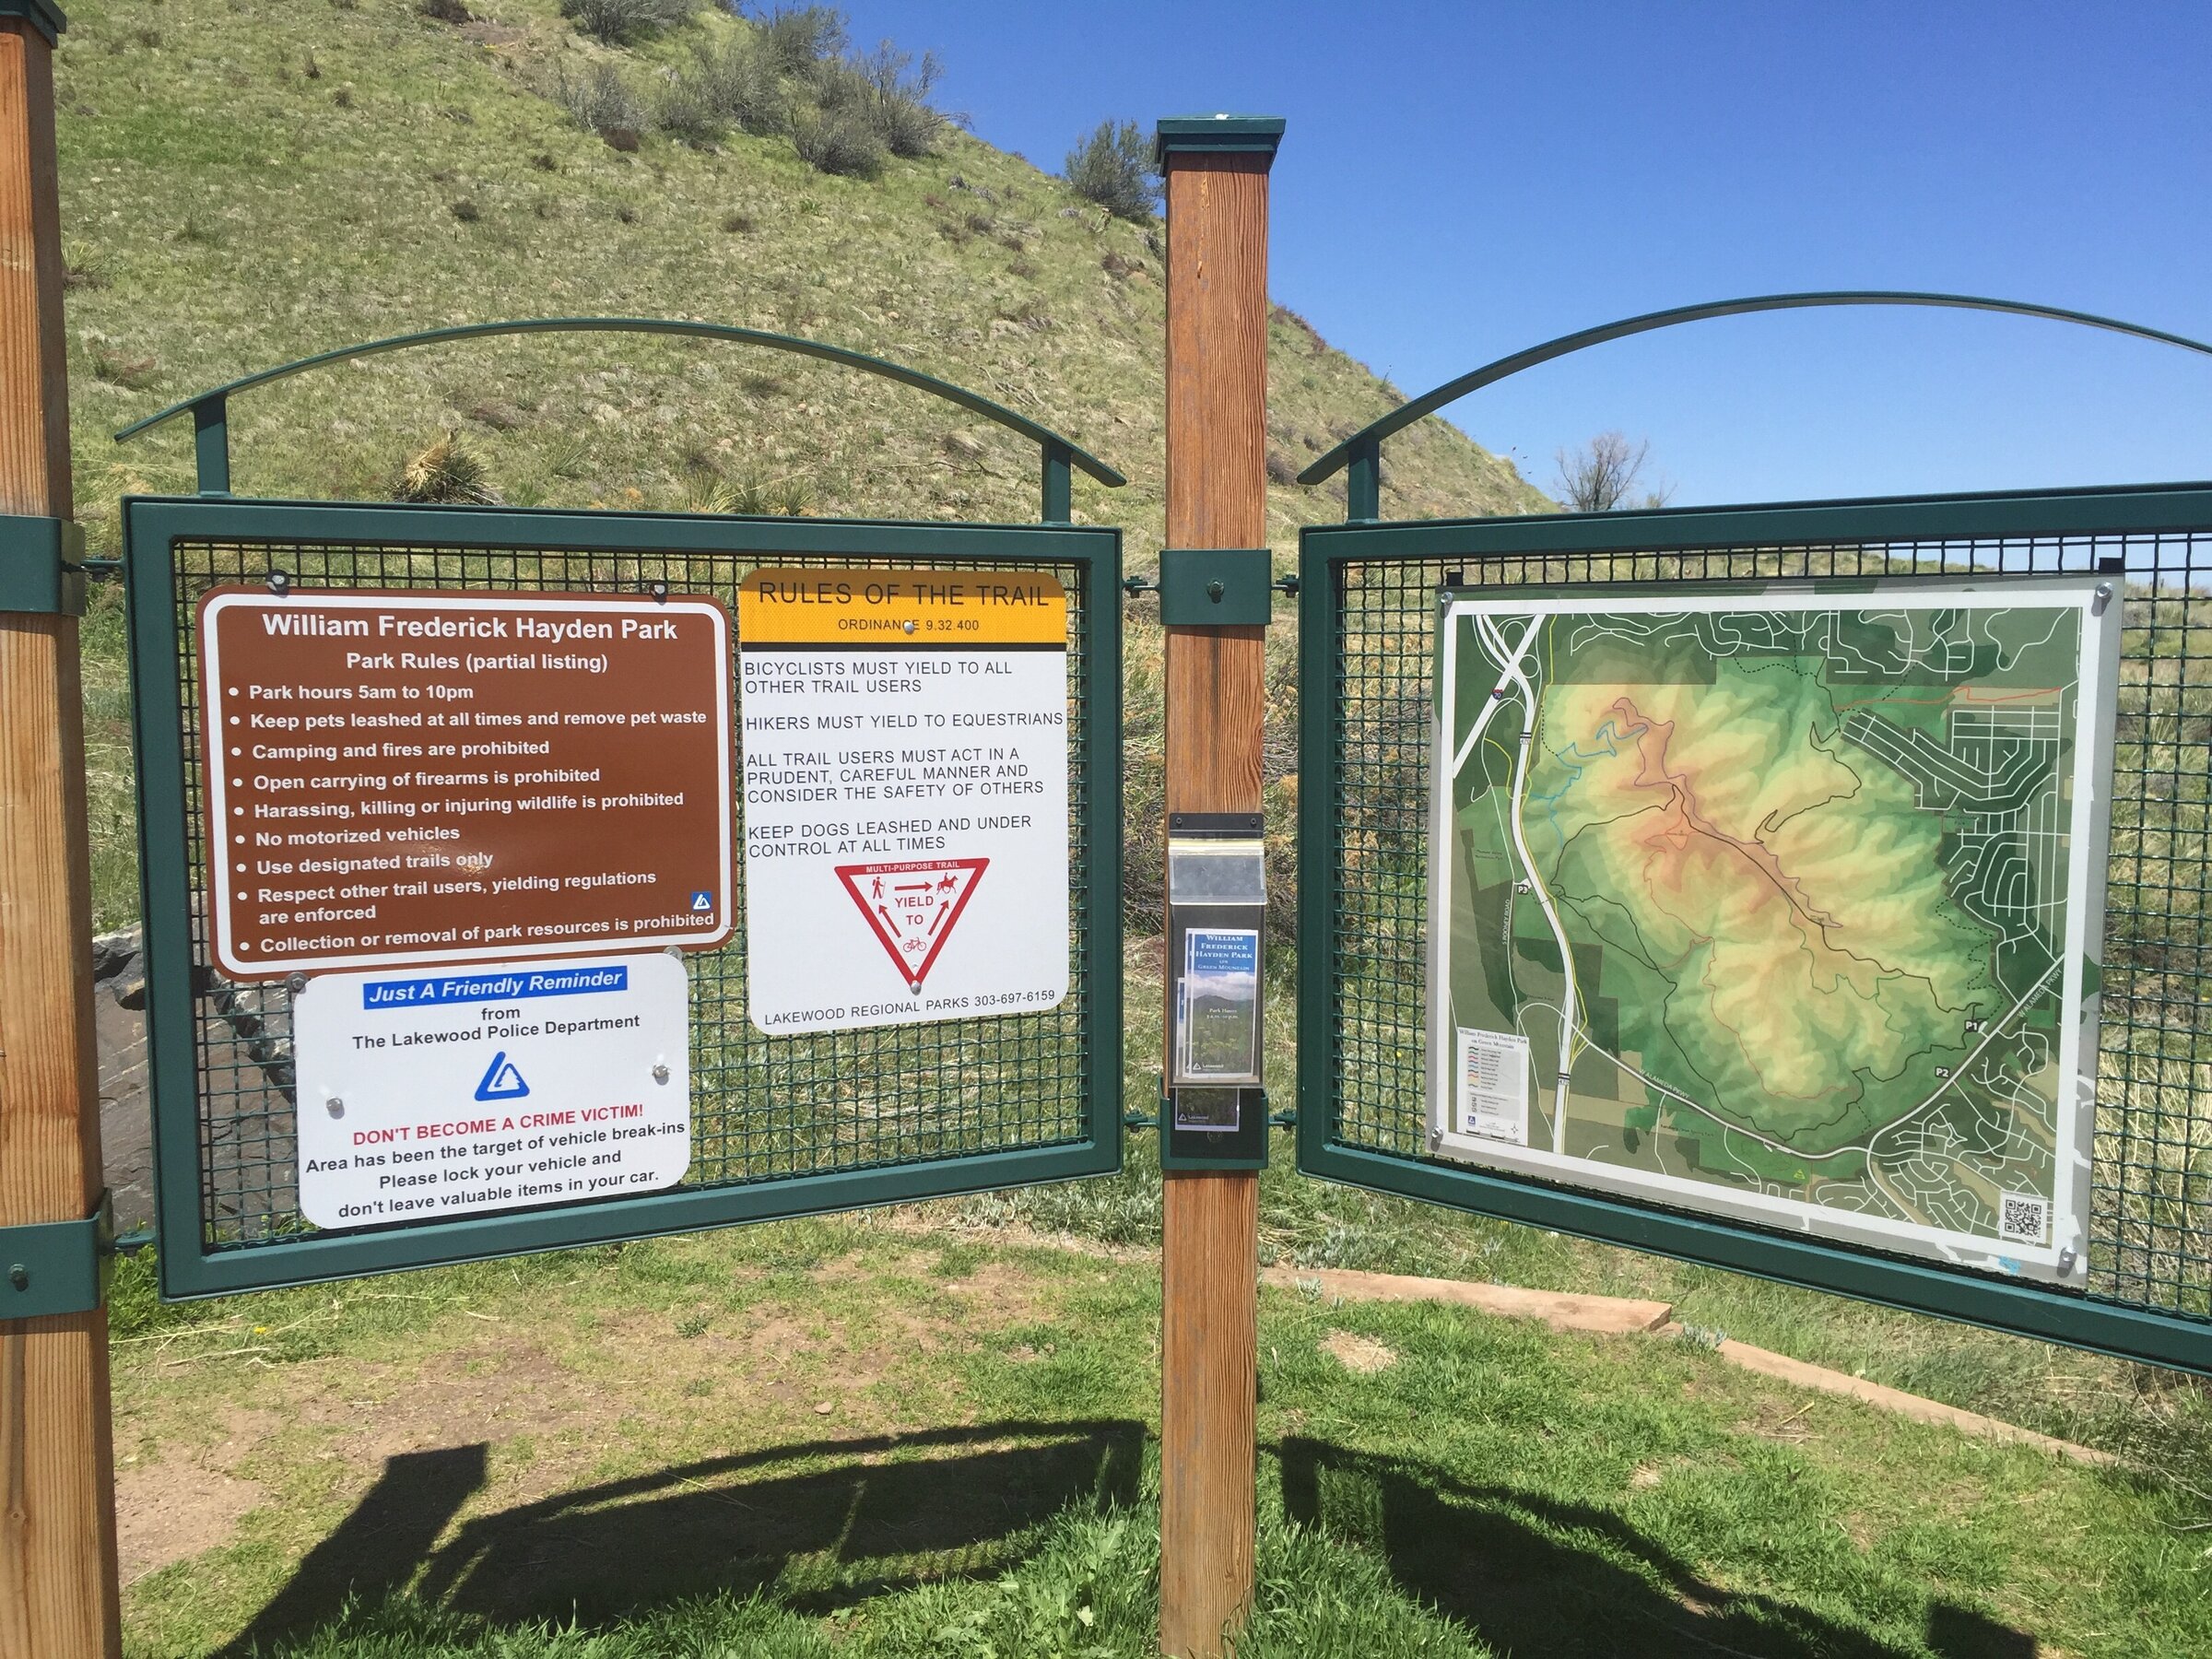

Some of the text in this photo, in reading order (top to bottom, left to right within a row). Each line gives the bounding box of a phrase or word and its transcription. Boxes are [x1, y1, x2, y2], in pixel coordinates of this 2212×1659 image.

[759, 582, 1049, 606] RULES OF THE TRAIL
[263, 614, 677, 643] William Frederick Hayden Park
[926, 619, 979, 630] 9.32.400
[347, 653, 607, 673] Park Rules (partial listing)
[746, 662, 1012, 676] BICYCLISTS MUST YIELD TO ALL
[250, 685, 473, 701] Park hours 5am to 10pm
[746, 679, 921, 693] OTHER TRAIL USERS
[251, 712, 706, 731] Keep pets leashed at all times and remove pet waste
[747, 712, 1063, 730] HIKERS MUST YIELD TO EQUESTRIANS
[253, 741, 549, 761] Camping and fires are prohibited
[747, 764, 1028, 784] PRUDENT, CAREFUL MANNER AND
[748, 781, 1043, 803] CONSIDER THE SAFETY OF OTHERS
[749, 816, 1031, 840] KEEP DOGS LEASHED AND UNDER
[749, 836, 945, 857] CONTROL AT ALL TIMES
[257, 852, 493, 875] Use designated trails only
[865, 861, 960, 873] MULTI-PURPOSE TRAIL
[258, 872, 656, 904] Respect other trail users, yielding regulations
[1518, 886, 1528, 894] P3
[895, 896, 934, 908] YIELD
[259, 905, 376, 924] are enforced
[906, 914, 924, 925] TO
[261, 913, 713, 952] Collection or removal of park resources is prohibited
[370, 971, 622, 1002] Just A Friendly Reminder
[2018, 967, 2063, 1018] W ALAMEDA PKWY
[481, 1008, 520, 1020] from
[765, 990, 1054, 1025] LAKEWOOD REGIONAL PARKS 303-697-6159
[352, 1016, 640, 1049] The Lakewood Police Department
[1965, 1021, 1978, 1030] P1
[1936, 1067, 1949, 1077] P2
[354, 1104, 642, 1145] DON'T BECOME A CRIME VICTIM!
[380, 1150, 620, 1189] Please lock your vehicle and
[339, 1171, 658, 1218] don't leave valuable items in your car.
